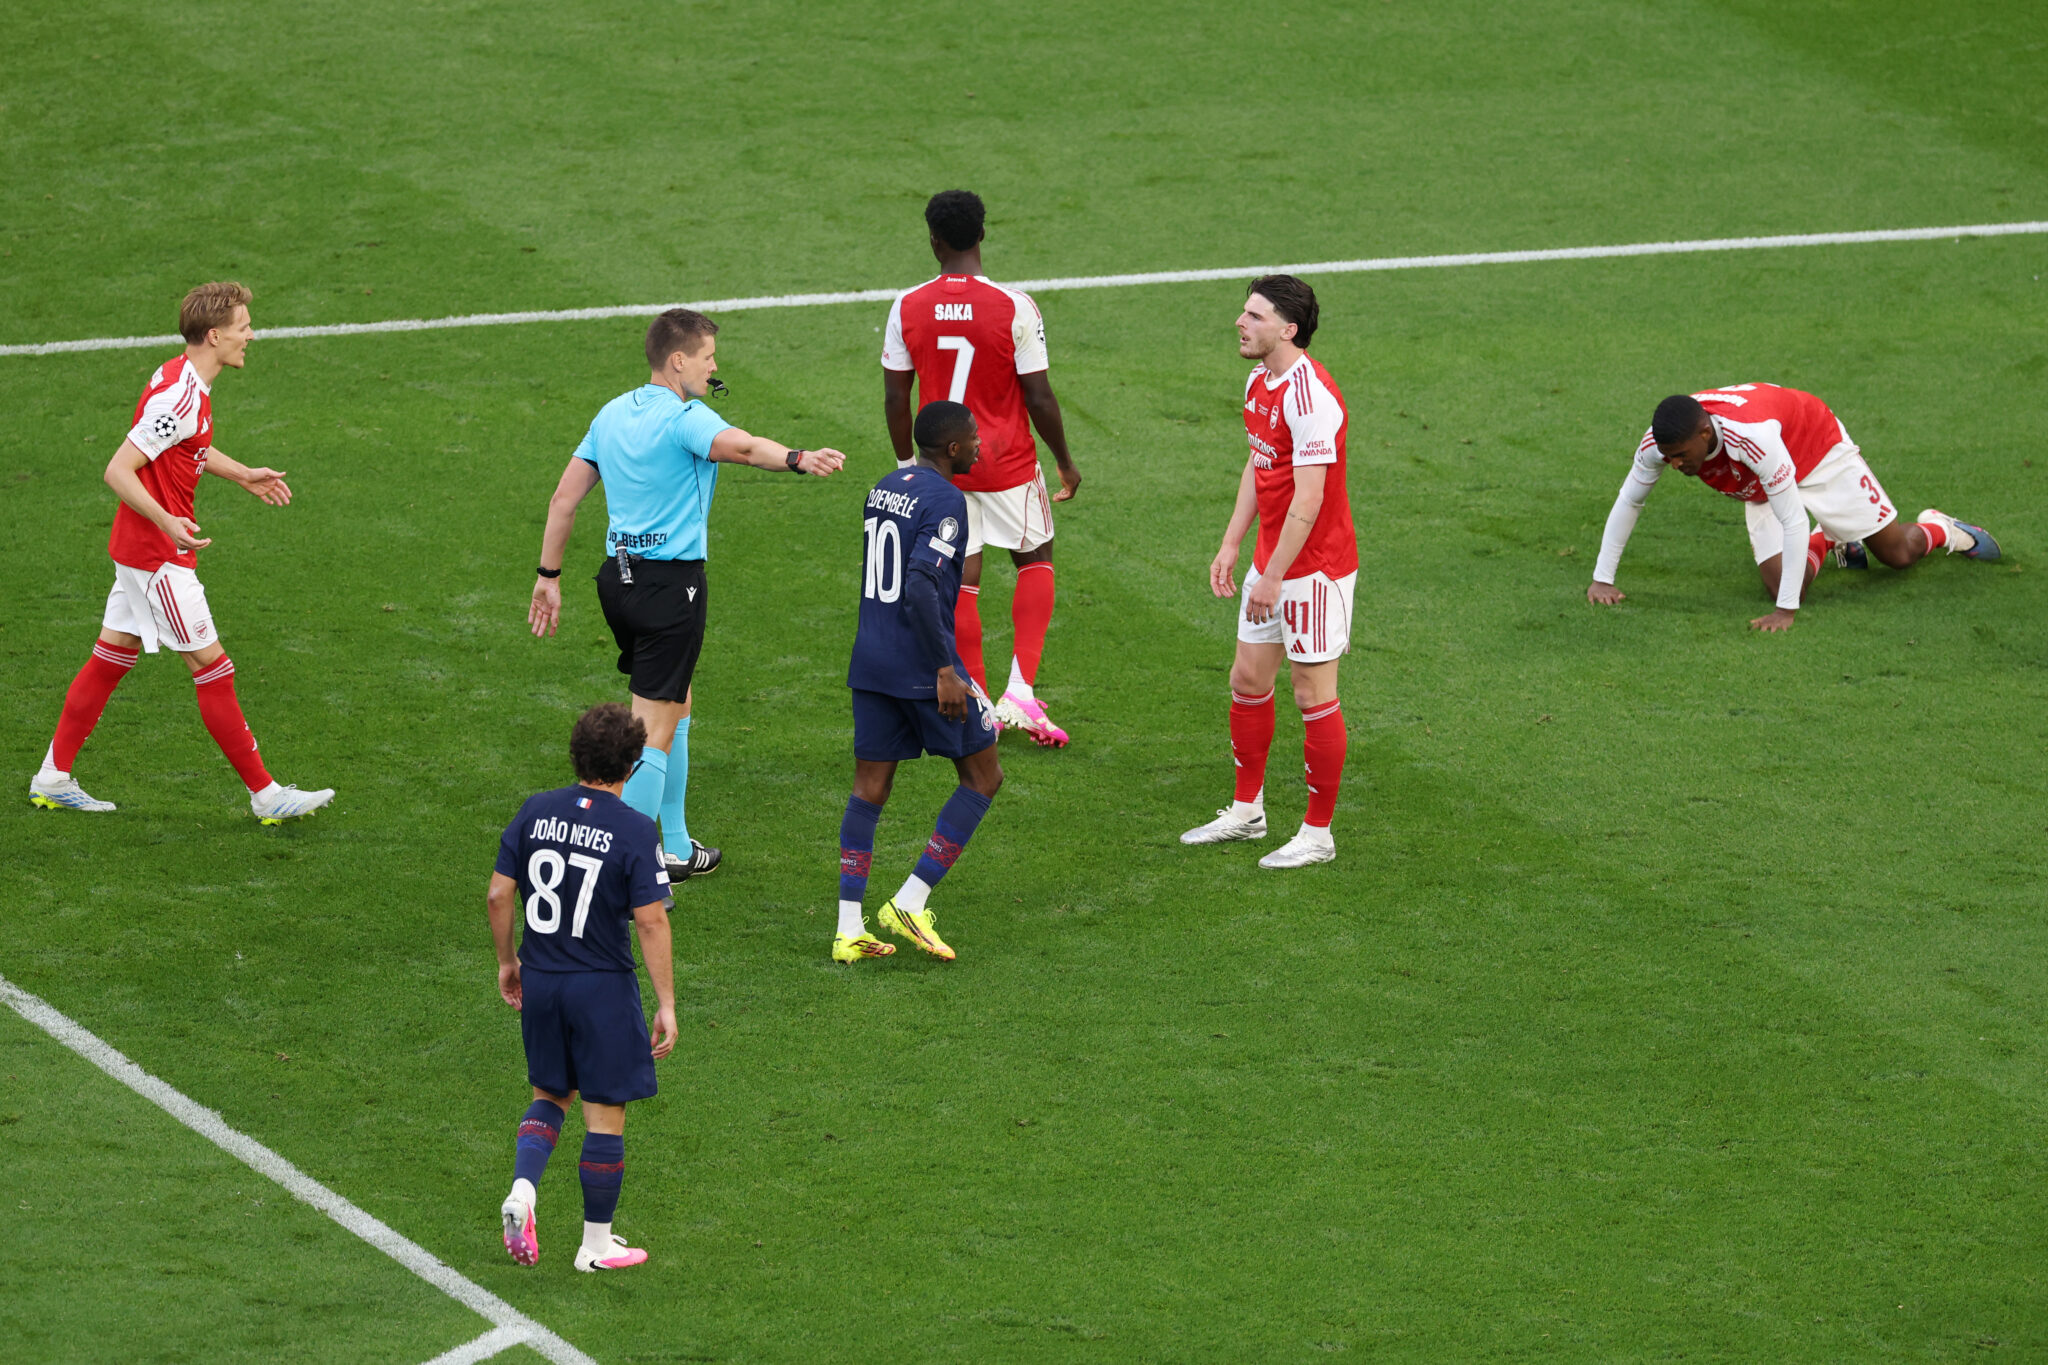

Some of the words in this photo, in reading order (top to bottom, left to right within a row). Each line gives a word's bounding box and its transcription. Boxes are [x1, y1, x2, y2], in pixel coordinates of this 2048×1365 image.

[934, 303, 973, 321] SAKA
[937, 336, 975, 404] 7
[1299, 447, 1333, 457] RWANDA
[1306, 440, 1325, 449] VISIT
[864, 516, 902, 604] 10
[1284, 599, 1309, 634] 41
[529, 816, 568, 843] JOÃO
[569, 823, 613, 853] NEVES
[526, 849, 604, 939] 87
[848, 940, 894, 956] F50
